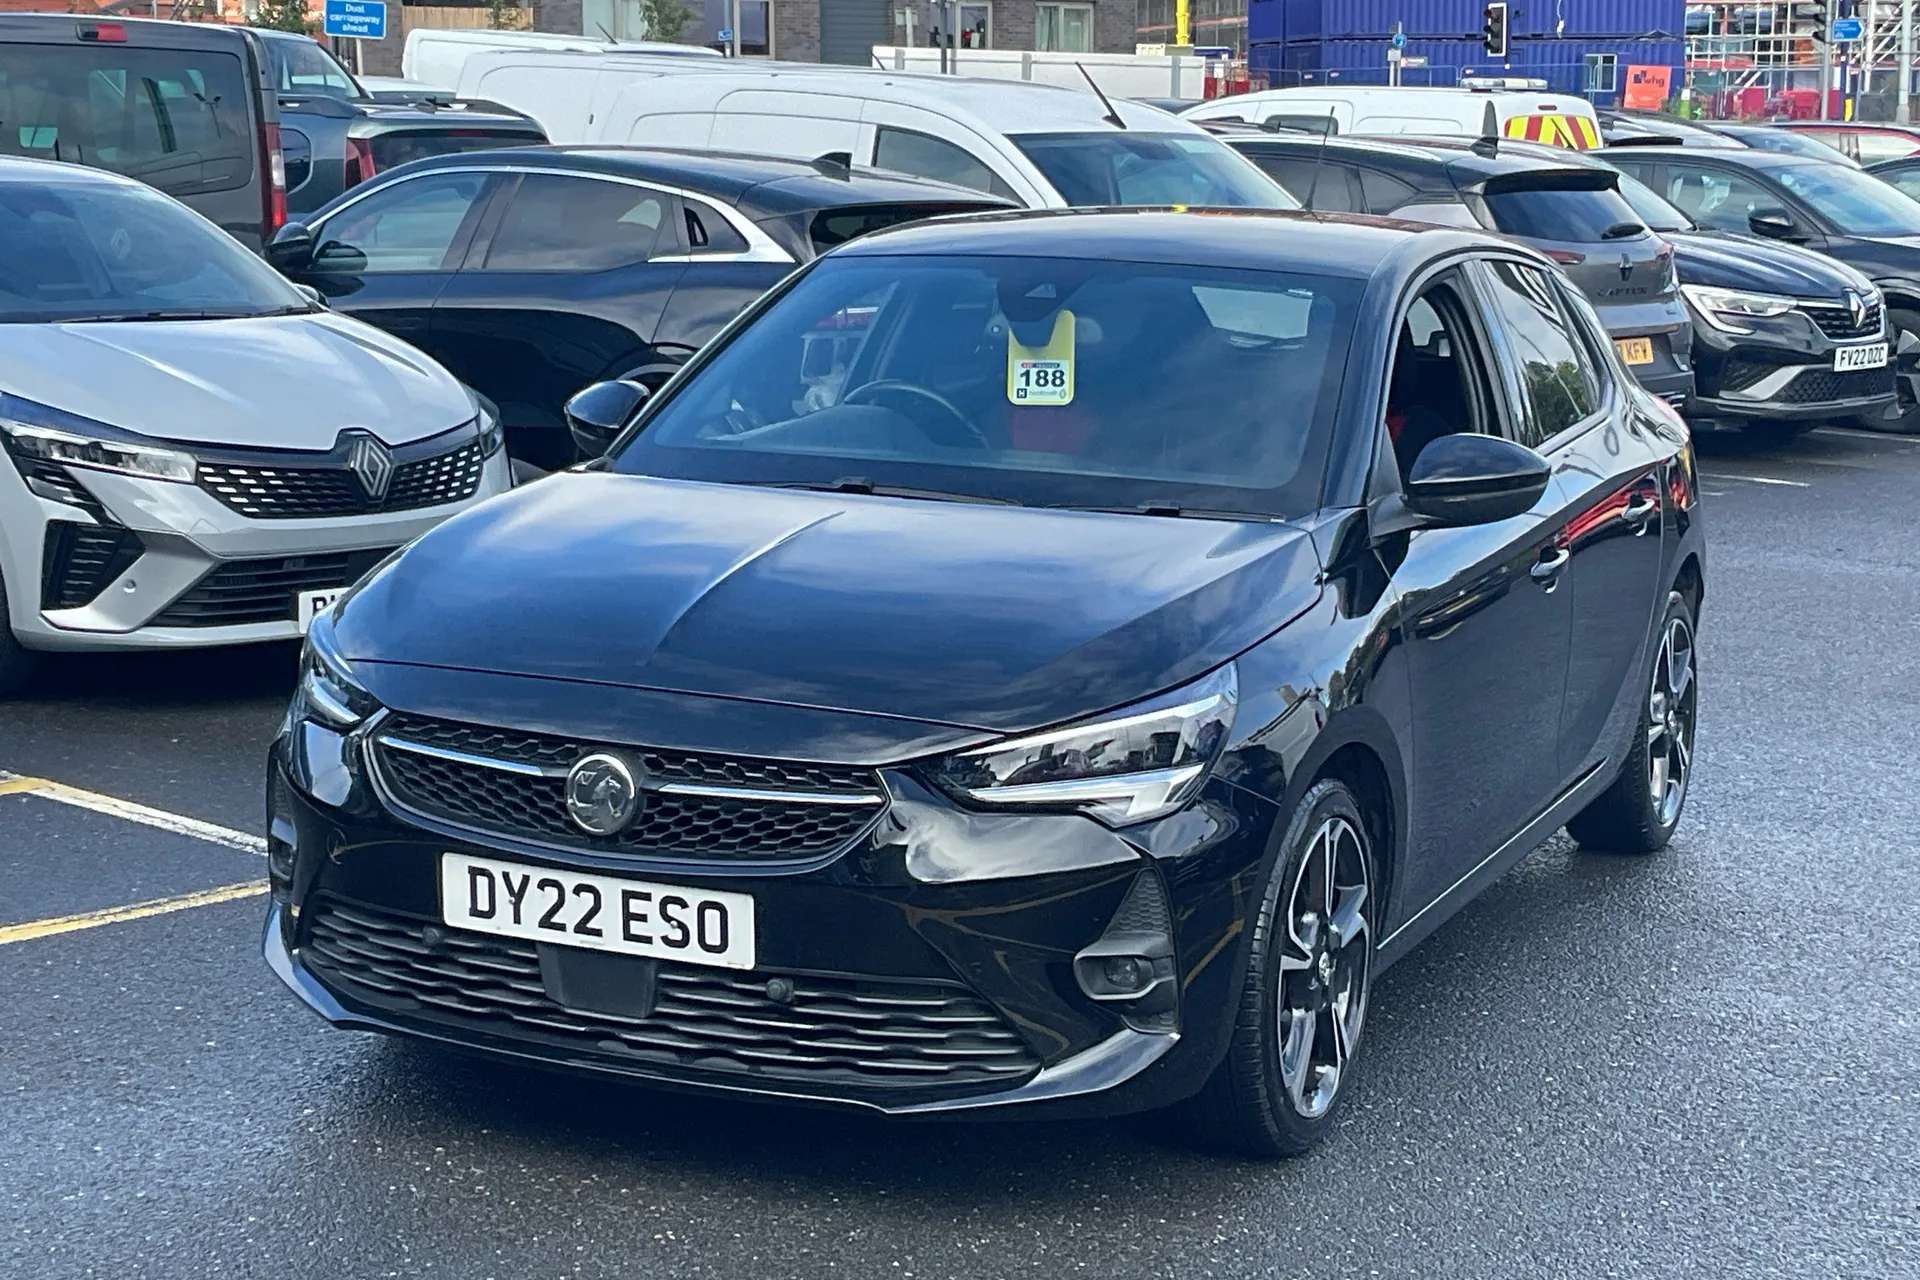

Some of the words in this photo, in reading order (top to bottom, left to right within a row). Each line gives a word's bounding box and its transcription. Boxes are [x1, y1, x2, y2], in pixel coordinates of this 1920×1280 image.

[345, 4, 365, 13] Dual
[329, 14, 380, 25] carriageway
[342, 23, 368, 33] ahead
[1840, 349, 1866, 367] FY22
[1867, 346, 1885, 364] DZC
[1020, 369, 1065, 388] 188
[468, 865, 604, 938] DY22
[621, 888, 730, 955] ESO
